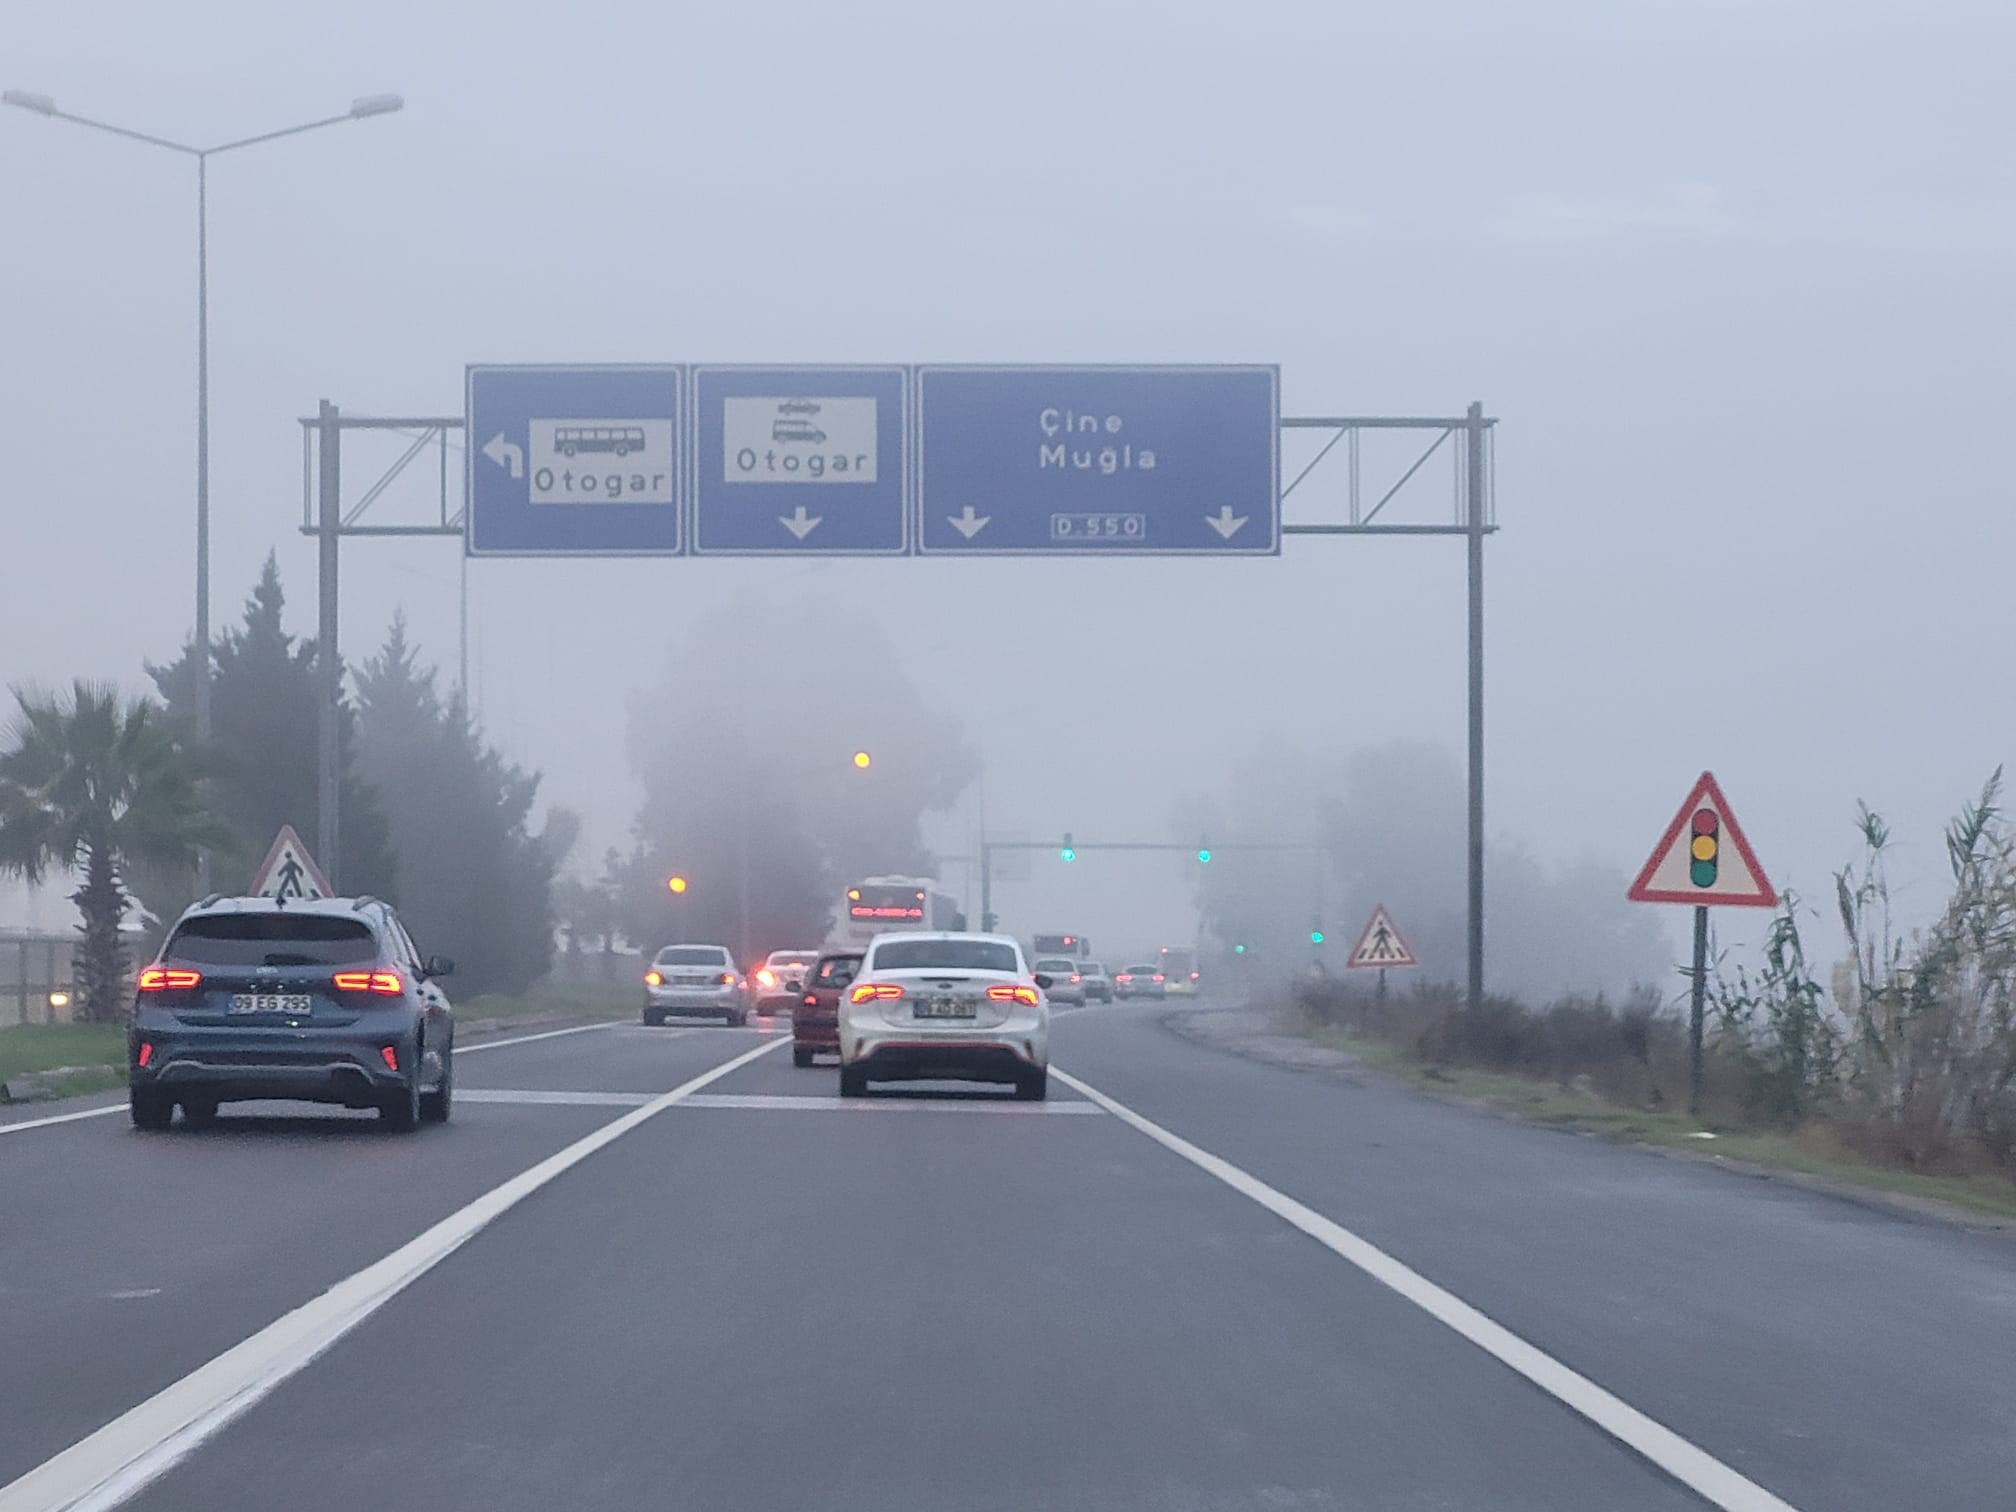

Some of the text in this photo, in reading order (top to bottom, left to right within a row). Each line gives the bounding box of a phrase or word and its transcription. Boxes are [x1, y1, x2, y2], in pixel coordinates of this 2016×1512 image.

[1040, 407, 1122, 437] Çine
[735, 447, 867, 477] Otogar
[534, 466, 665, 498] Otogar
